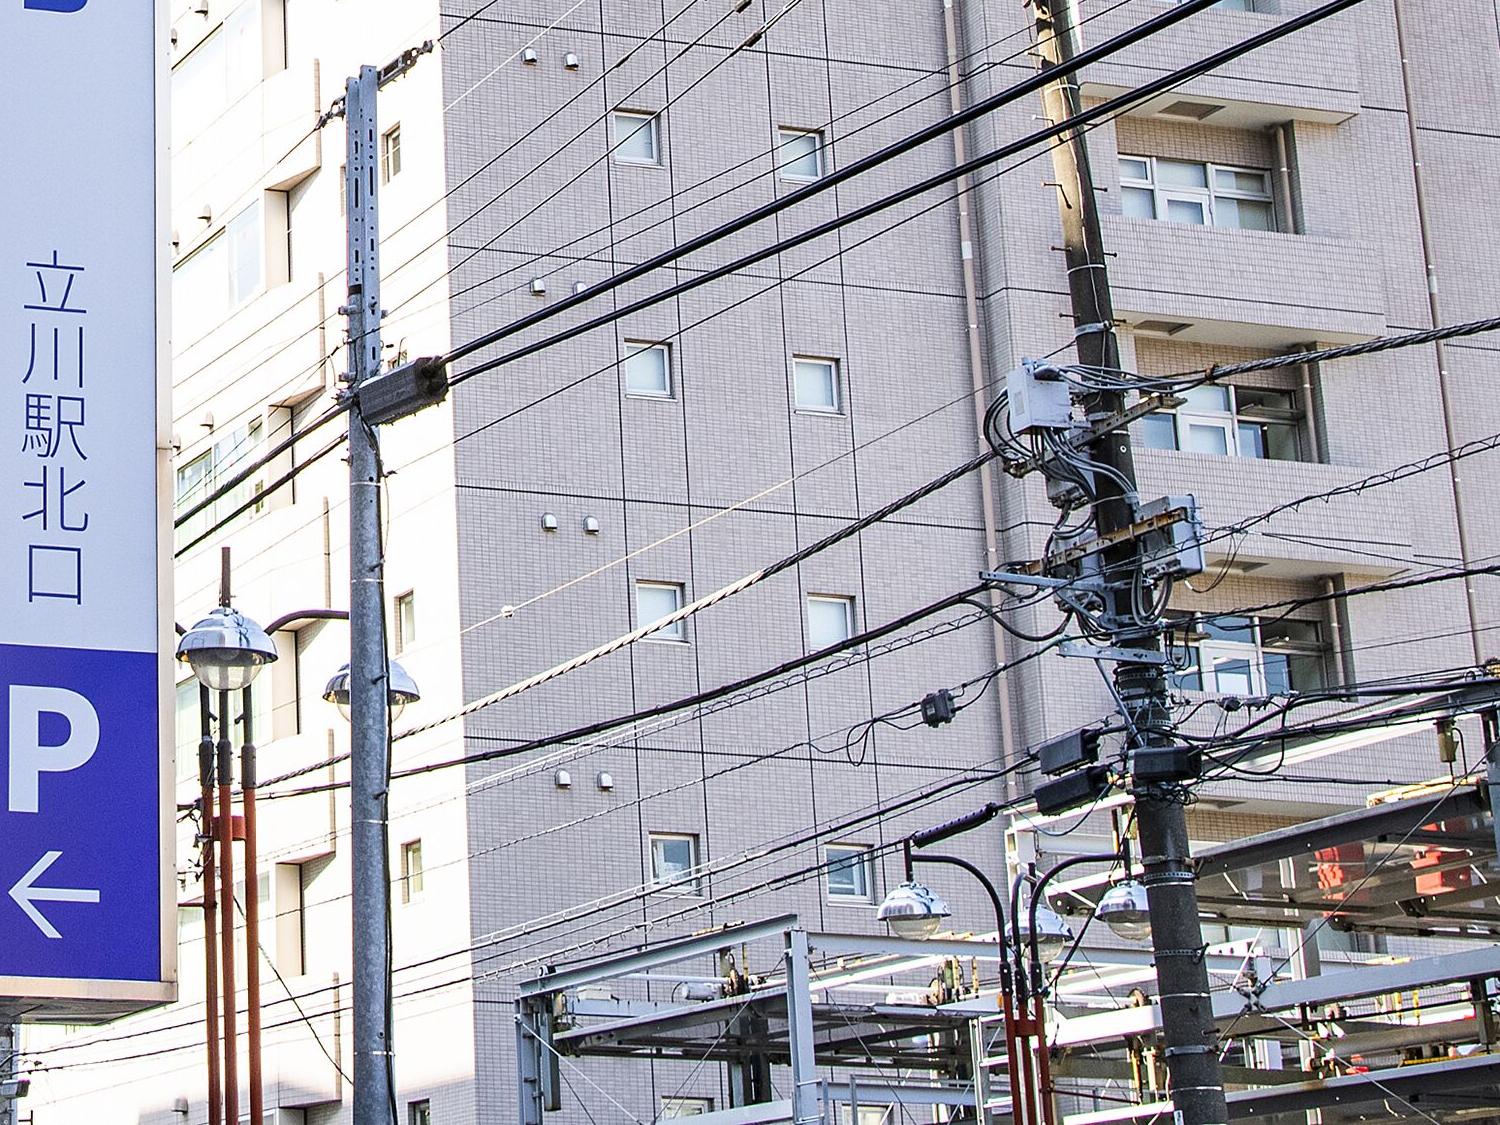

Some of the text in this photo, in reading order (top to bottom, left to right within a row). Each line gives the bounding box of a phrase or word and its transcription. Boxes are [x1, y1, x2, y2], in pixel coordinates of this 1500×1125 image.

[21, 250, 90, 607] 立川駅北口
[8, 684, 101, 814] P
